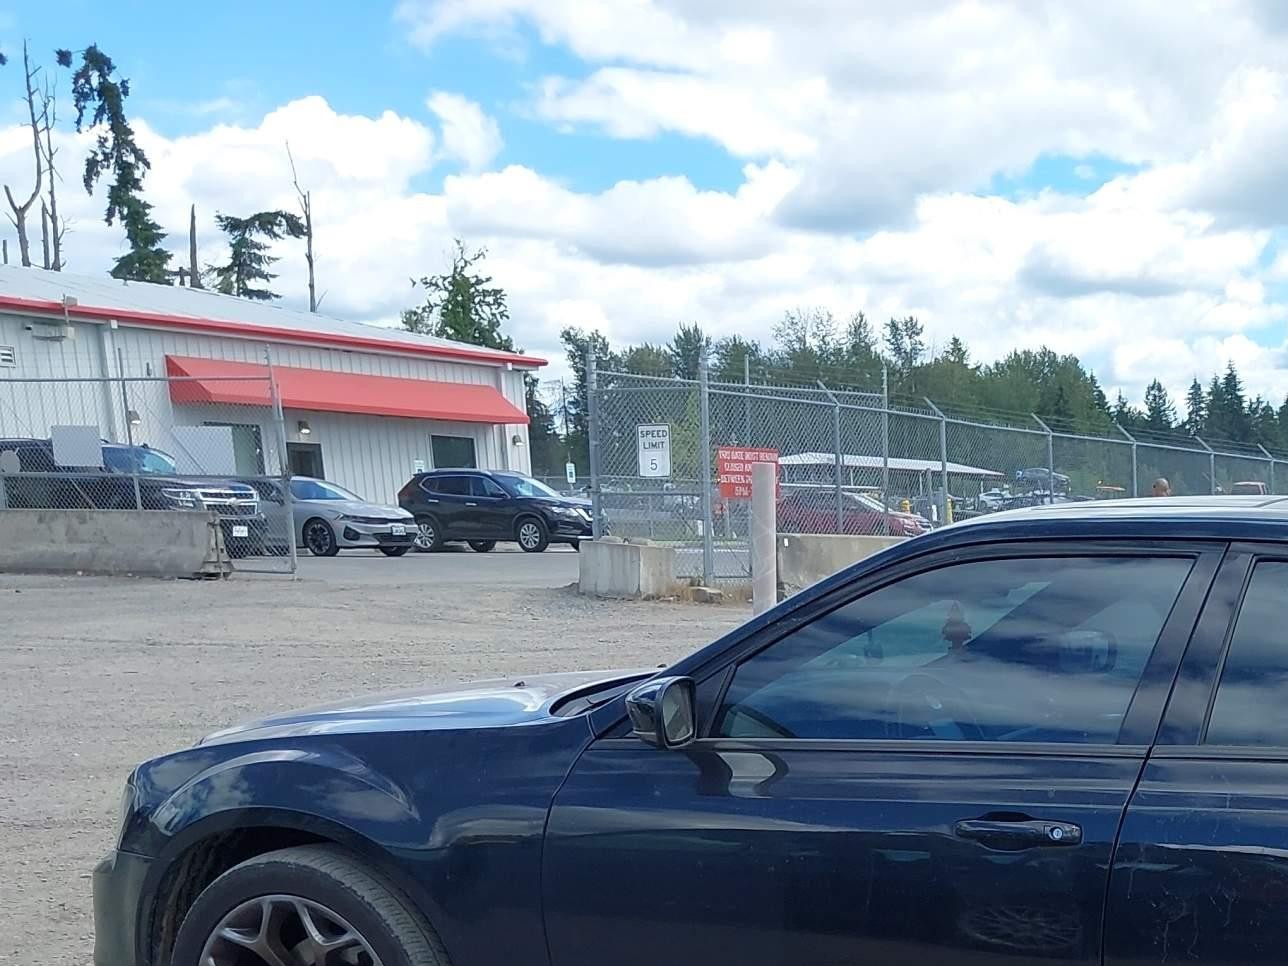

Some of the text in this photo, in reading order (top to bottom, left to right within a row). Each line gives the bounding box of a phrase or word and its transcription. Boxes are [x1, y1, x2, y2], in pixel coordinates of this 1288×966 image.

[640, 430, 667, 438] SPEED
[643, 441, 664, 449] LIMIT
[650, 459, 657, 470] 5
[720, 474, 745, 484] BETWEEN
